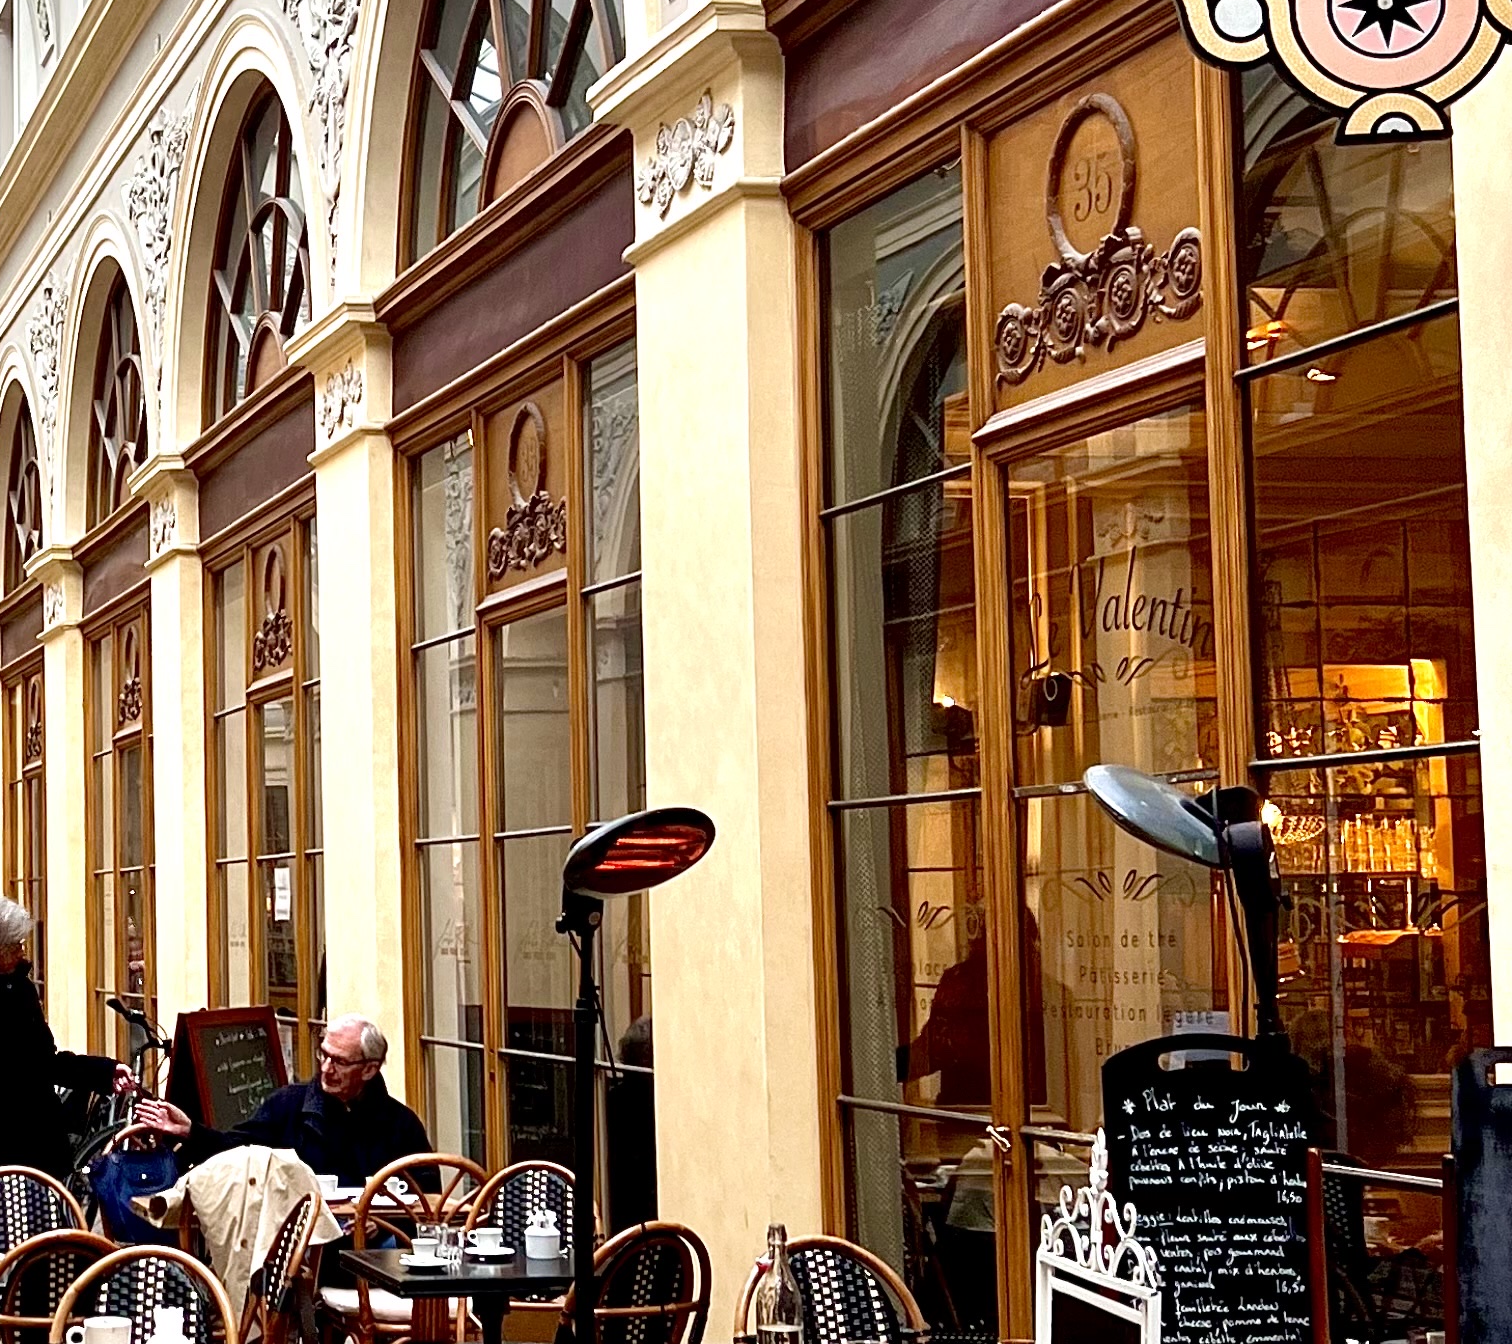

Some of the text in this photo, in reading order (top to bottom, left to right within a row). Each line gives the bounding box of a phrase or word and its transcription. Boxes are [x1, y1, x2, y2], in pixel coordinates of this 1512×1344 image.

[1074, 151, 1112, 223] 35
[1068, 545, 1212, 657] Valentin
[1066, 930, 1110, 948] Salon
[1120, 930, 1139, 948] de
[1142, 1087, 1176, 1112] Plat
[1193, 1095, 1215, 1110] du
[1130, 1124, 1151, 1142] Dos
[1159, 1123, 1172, 1138] de
[1187, 1140, 1201, 1154] de
[1276, 1189, 1303, 1205] 16,50
[1232, 1232, 1258, 1243] aux
[1217, 1265, 1240, 1277] mix
[1276, 1278, 1306, 1295] 16,50
[1266, 1314, 1280, 1325] de
